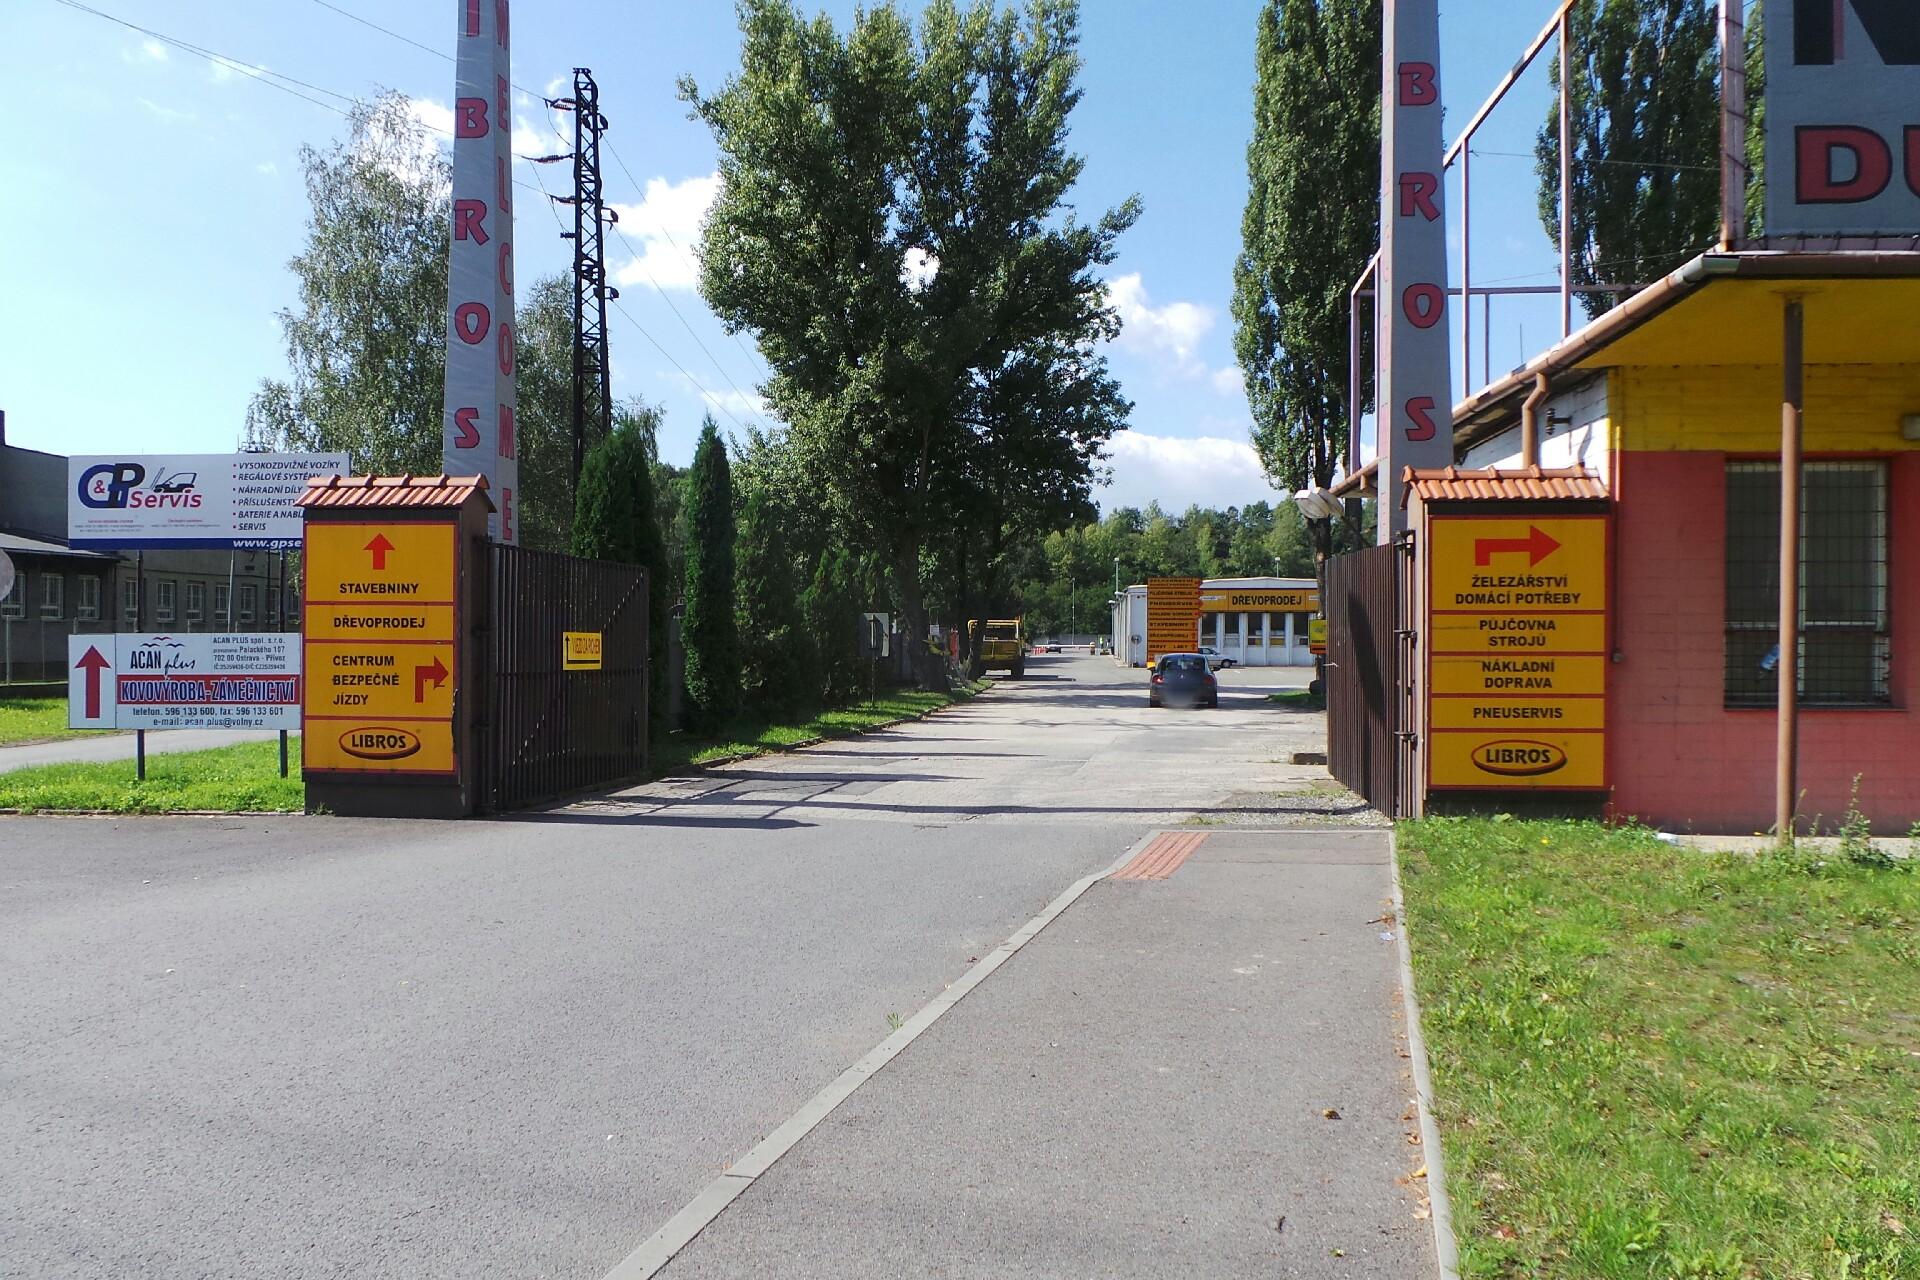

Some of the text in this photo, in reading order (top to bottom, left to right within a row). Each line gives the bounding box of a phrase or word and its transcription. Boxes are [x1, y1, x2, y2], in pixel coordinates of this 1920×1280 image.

[1397, 62, 1444, 442] BROS
[238, 460, 340, 470] VYSOKOZDVIŽNÉ VOZÍKY
[237, 472, 283, 481] REGÁLOVÉ
[237, 484, 303, 494] NÁHRADNÍ DÍLY
[129, 490, 203, 509] Servis
[237, 510, 272, 519] BATERIE
[273, 510, 279, 519] A
[237, 522, 267, 531] SERVIS
[1471, 574, 1568, 588] ŽELEZÁŘSTVÍ
[339, 583, 419, 594] STAVEBNINY
[1232, 595, 1302, 605] DŘEVOPRODEJ
[1455, 591, 1581, 605] DOMÁCÍ POTŘEBY
[333, 615, 426, 628] DŘEVOPRODEJ
[1479, 618, 1556, 630] PŮJČOVNA
[130, 650, 196, 680] ACAN plus
[332, 655, 395, 666] CENTRUM
[1482, 659, 1555, 673] NÁKLADNÍ
[332, 673, 400, 686] BEZPEČNÉ
[1484, 677, 1553, 689] DOPRAVA
[121, 677, 296, 702] KOVOVÝROBA-ZÁMEČNICTVÍ
[332, 692, 369, 705] JÍZDY
[164, 707, 181, 716] 596
[183, 707, 198, 716] 133
[235, 707, 250, 716] 596
[252, 707, 267, 716] 133
[269, 707, 283, 716] 601
[1473, 707, 1563, 719] PNEUSERVIS
[351, 734, 407, 749] LIBROS
[1486, 748, 1551, 764] LIBROS
